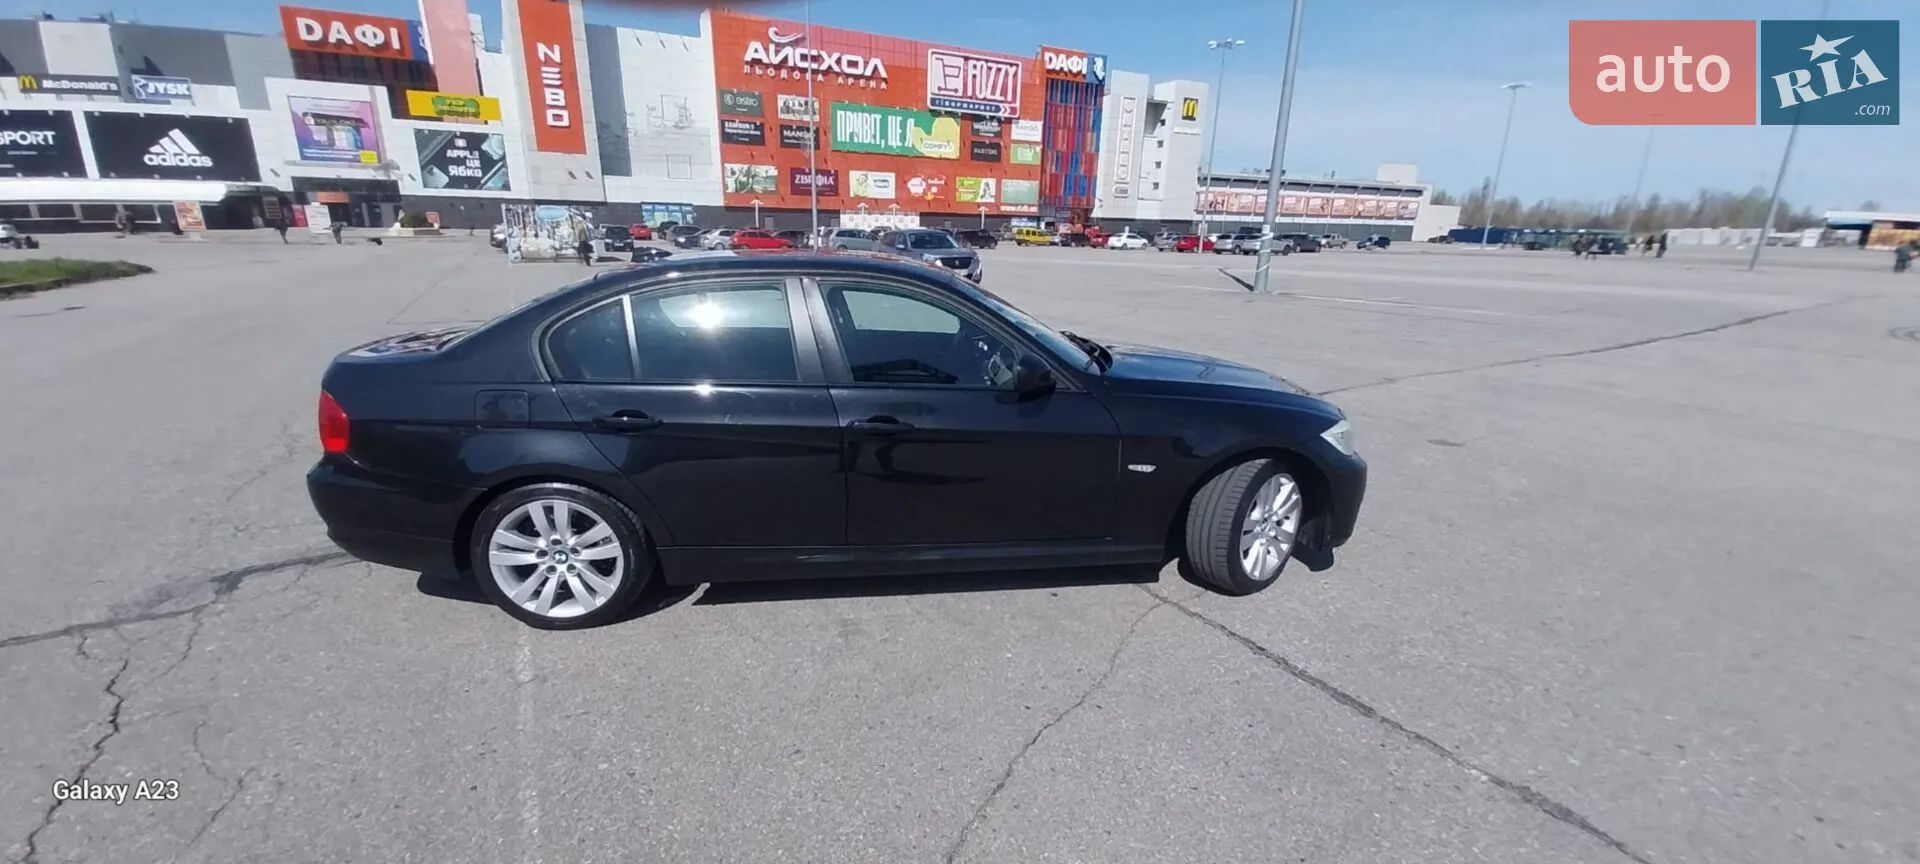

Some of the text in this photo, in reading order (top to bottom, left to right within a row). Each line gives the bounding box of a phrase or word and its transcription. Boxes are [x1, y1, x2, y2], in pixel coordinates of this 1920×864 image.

[42, 80, 118, 91] McDonald's
[147, 81, 191, 95] JYSK
[536, 42, 570, 127] NEBO
[967, 60, 1017, 104] FOZZY
[143, 152, 213, 168] adidas
